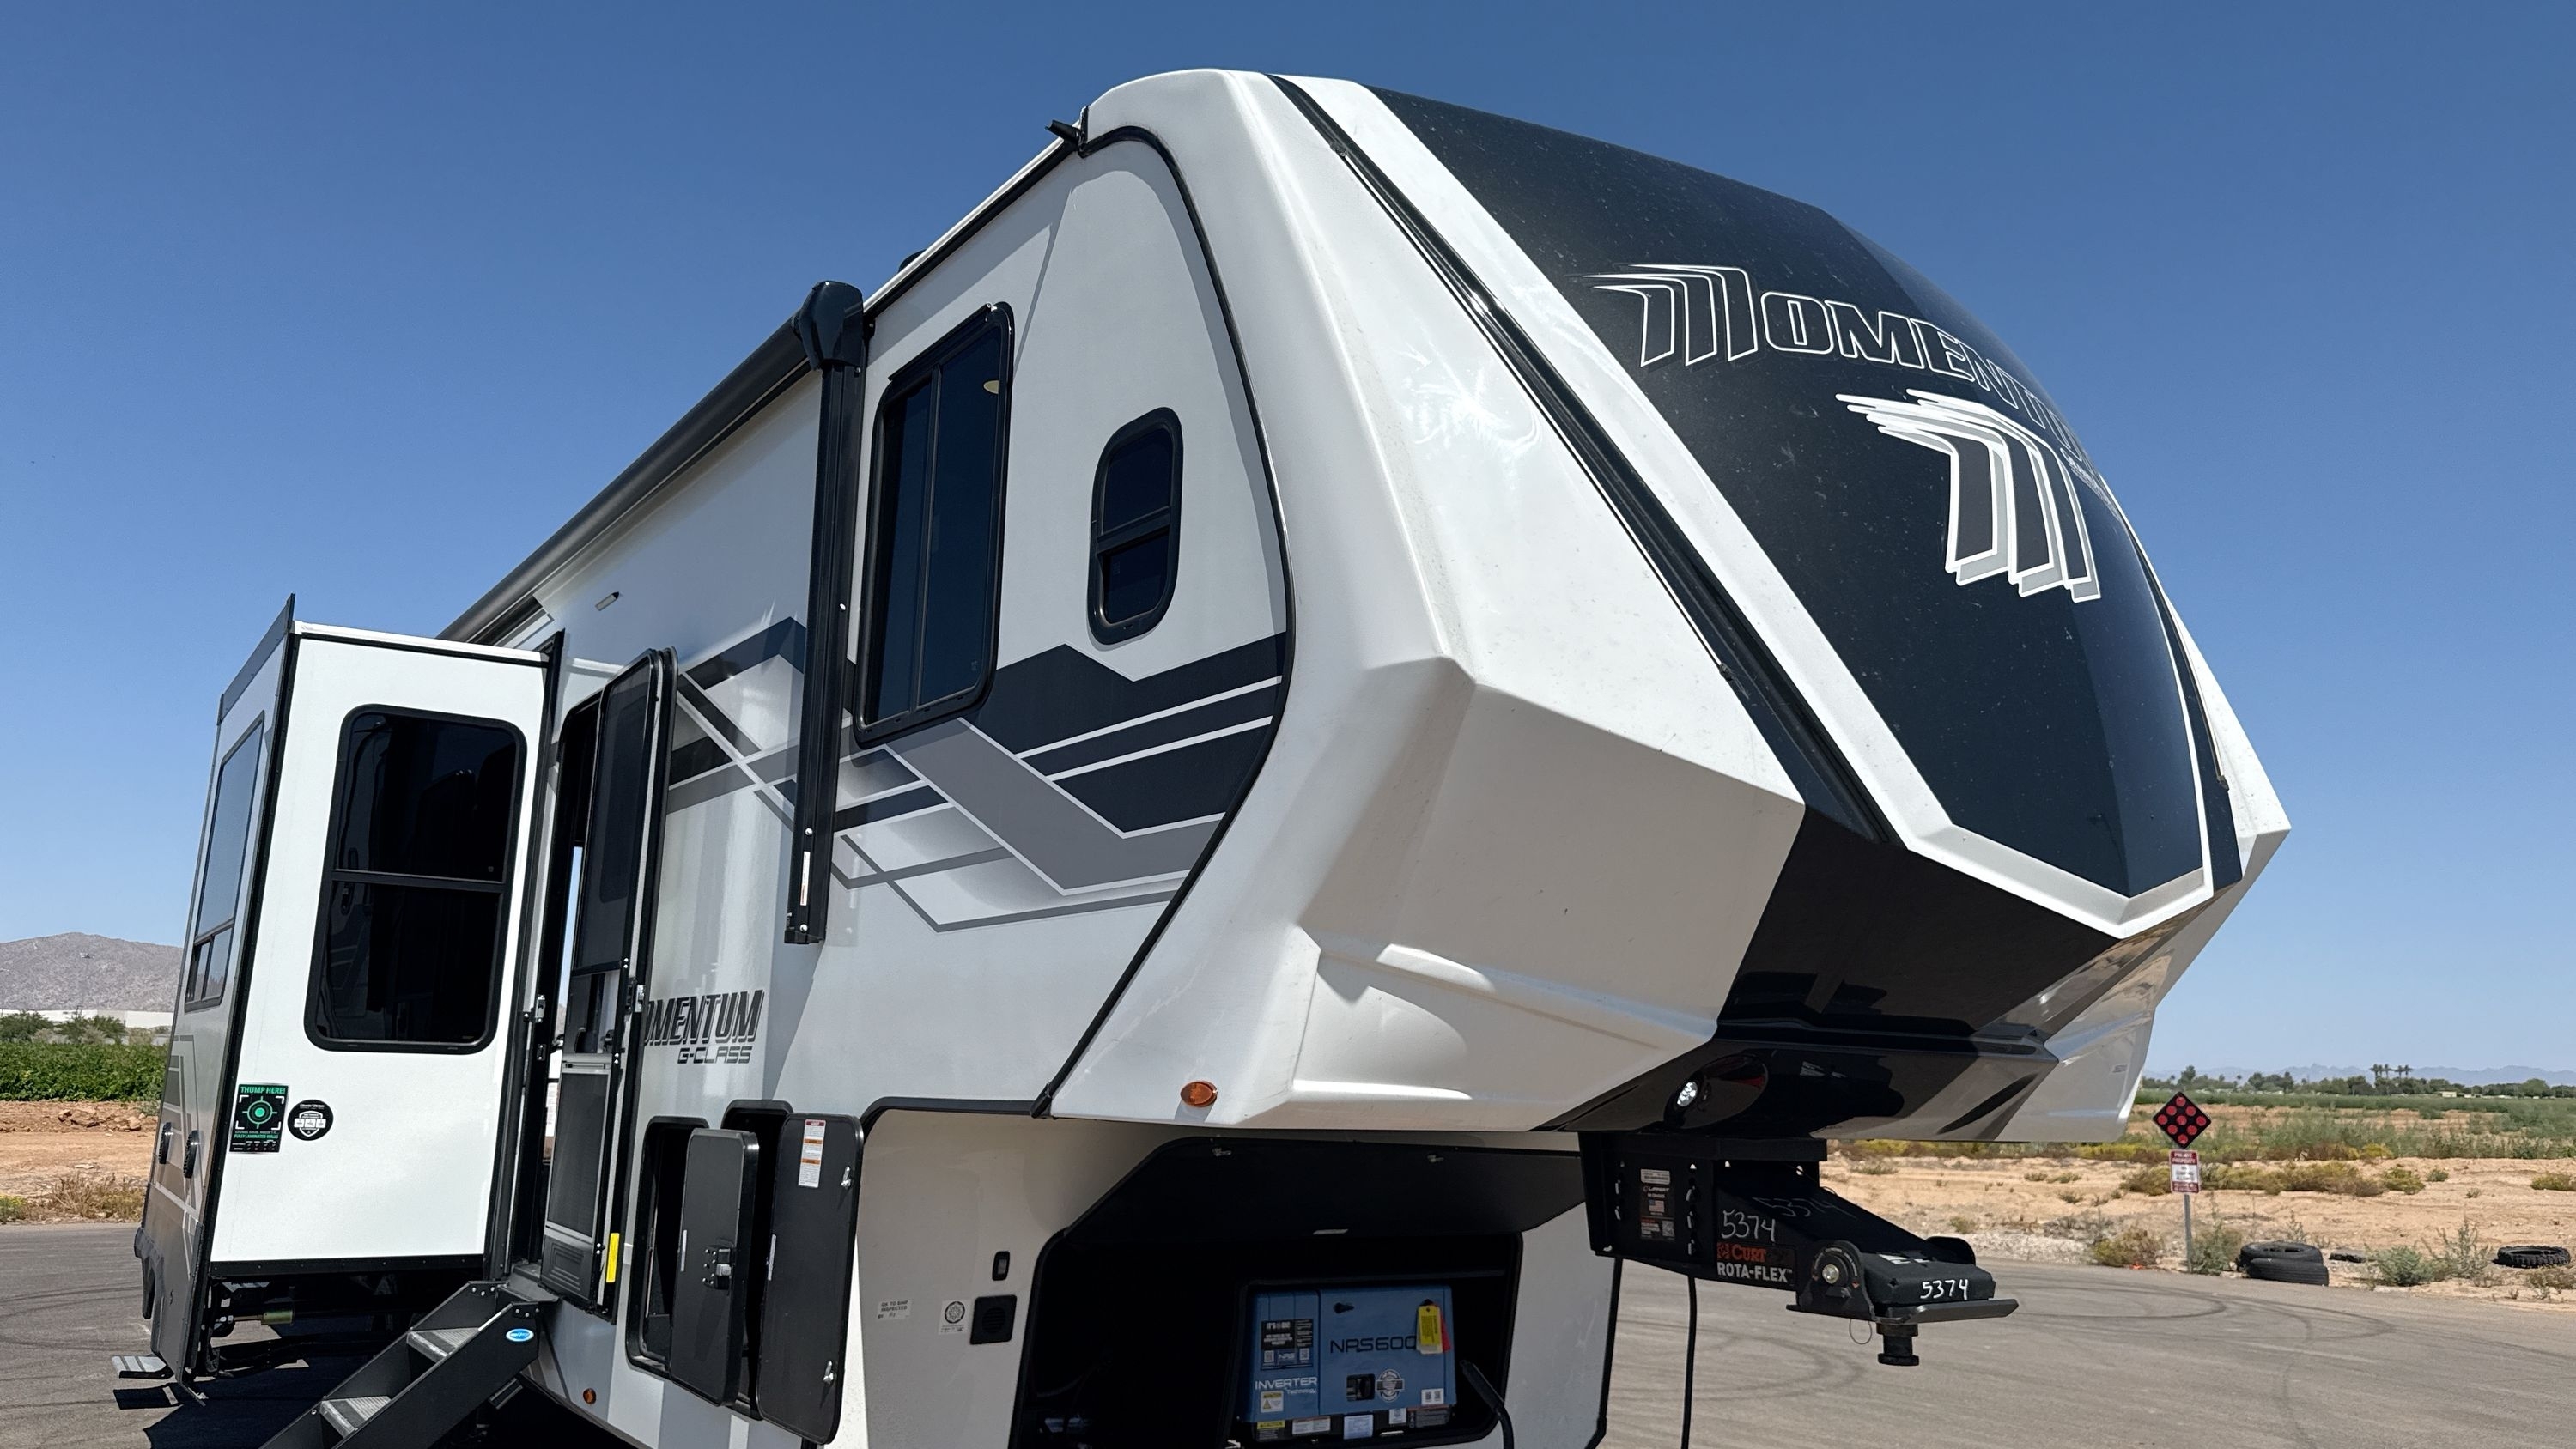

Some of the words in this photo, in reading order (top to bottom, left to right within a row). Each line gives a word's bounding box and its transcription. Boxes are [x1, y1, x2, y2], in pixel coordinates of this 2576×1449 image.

[677, 1045, 753, 1064] G-CLASS
[1720, 1208, 1776, 1242] 5374
[1919, 1277, 1969, 1301] 5374
[1255, 1376, 1318, 1391] INVERTER
